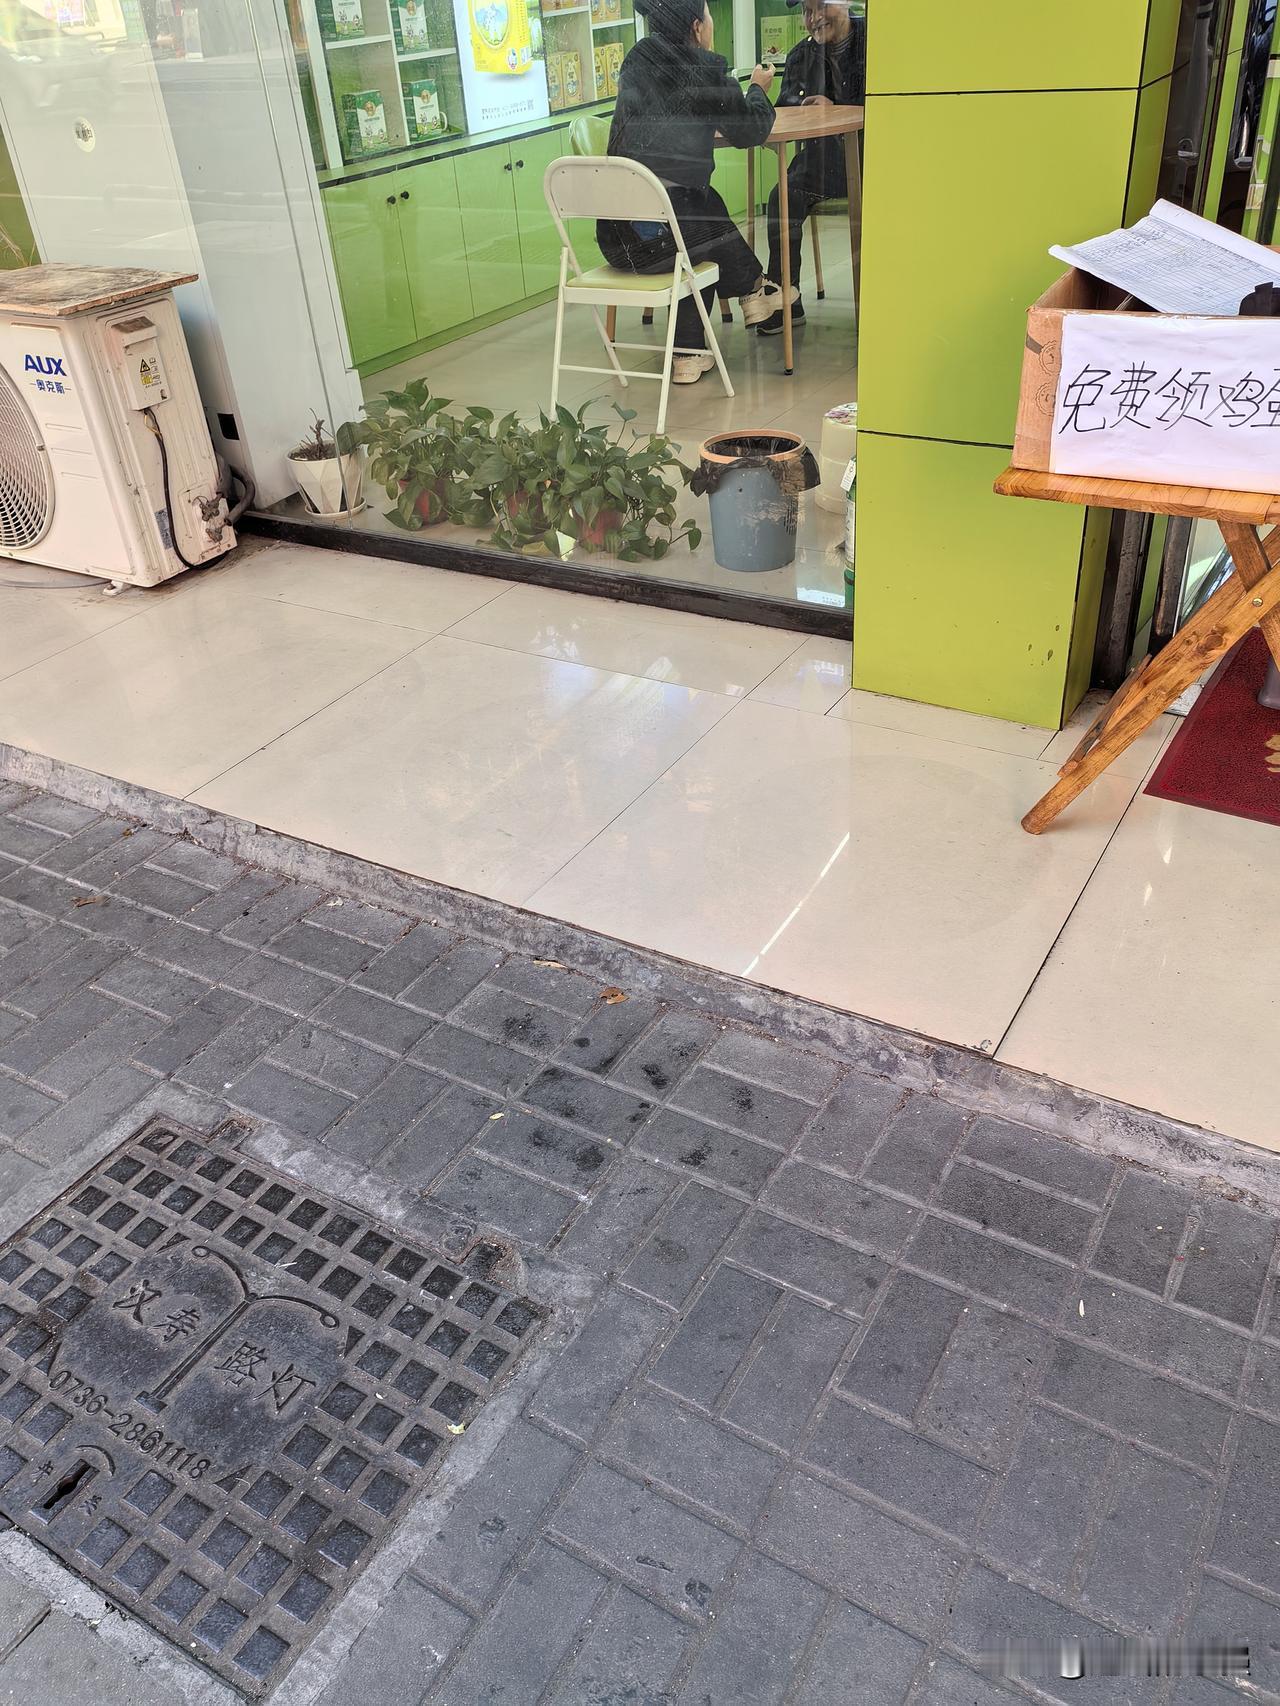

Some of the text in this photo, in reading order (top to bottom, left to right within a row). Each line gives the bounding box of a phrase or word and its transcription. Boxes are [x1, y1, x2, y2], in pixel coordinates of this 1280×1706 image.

[24, 354, 67, 377] AUX
[36, 379, 65, 394] 奥克斯
[112, 1279, 317, 1415] 汉寿 路灯
[49, 1370, 211, 1480] 0736-2861118
